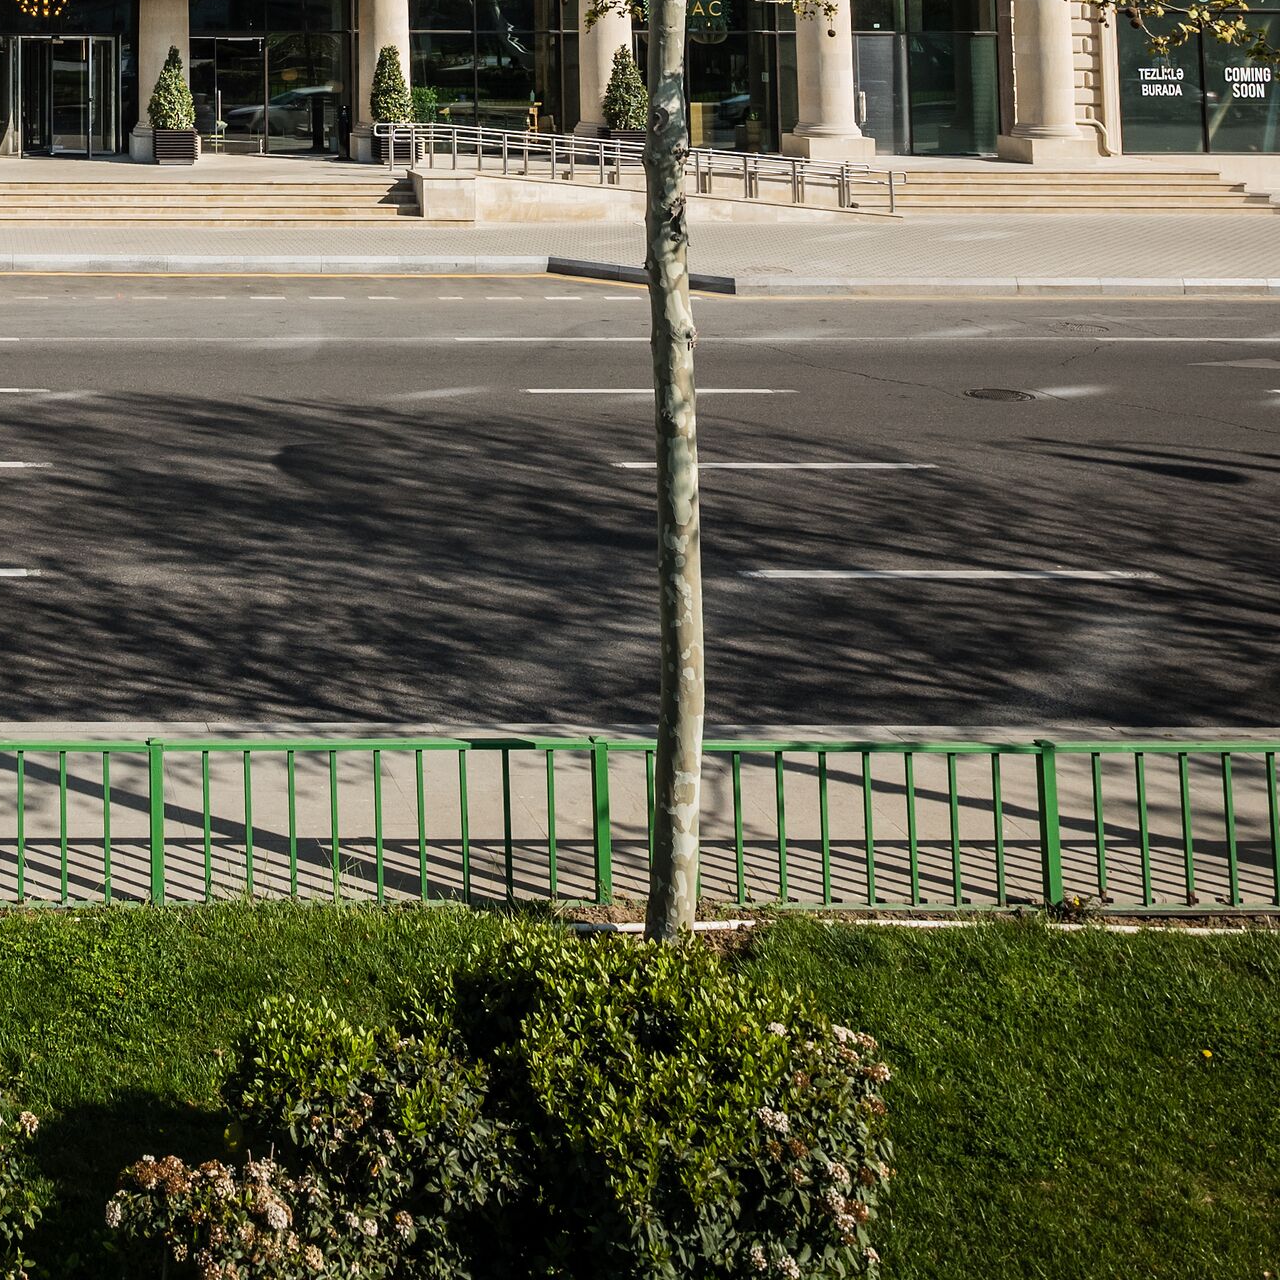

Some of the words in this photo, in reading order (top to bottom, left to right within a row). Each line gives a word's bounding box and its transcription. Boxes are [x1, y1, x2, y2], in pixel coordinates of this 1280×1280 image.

[1224, 67, 1271, 82] COMING
[1141, 84, 1183, 97] BURADA
[1232, 83, 1265, 98] SOON
